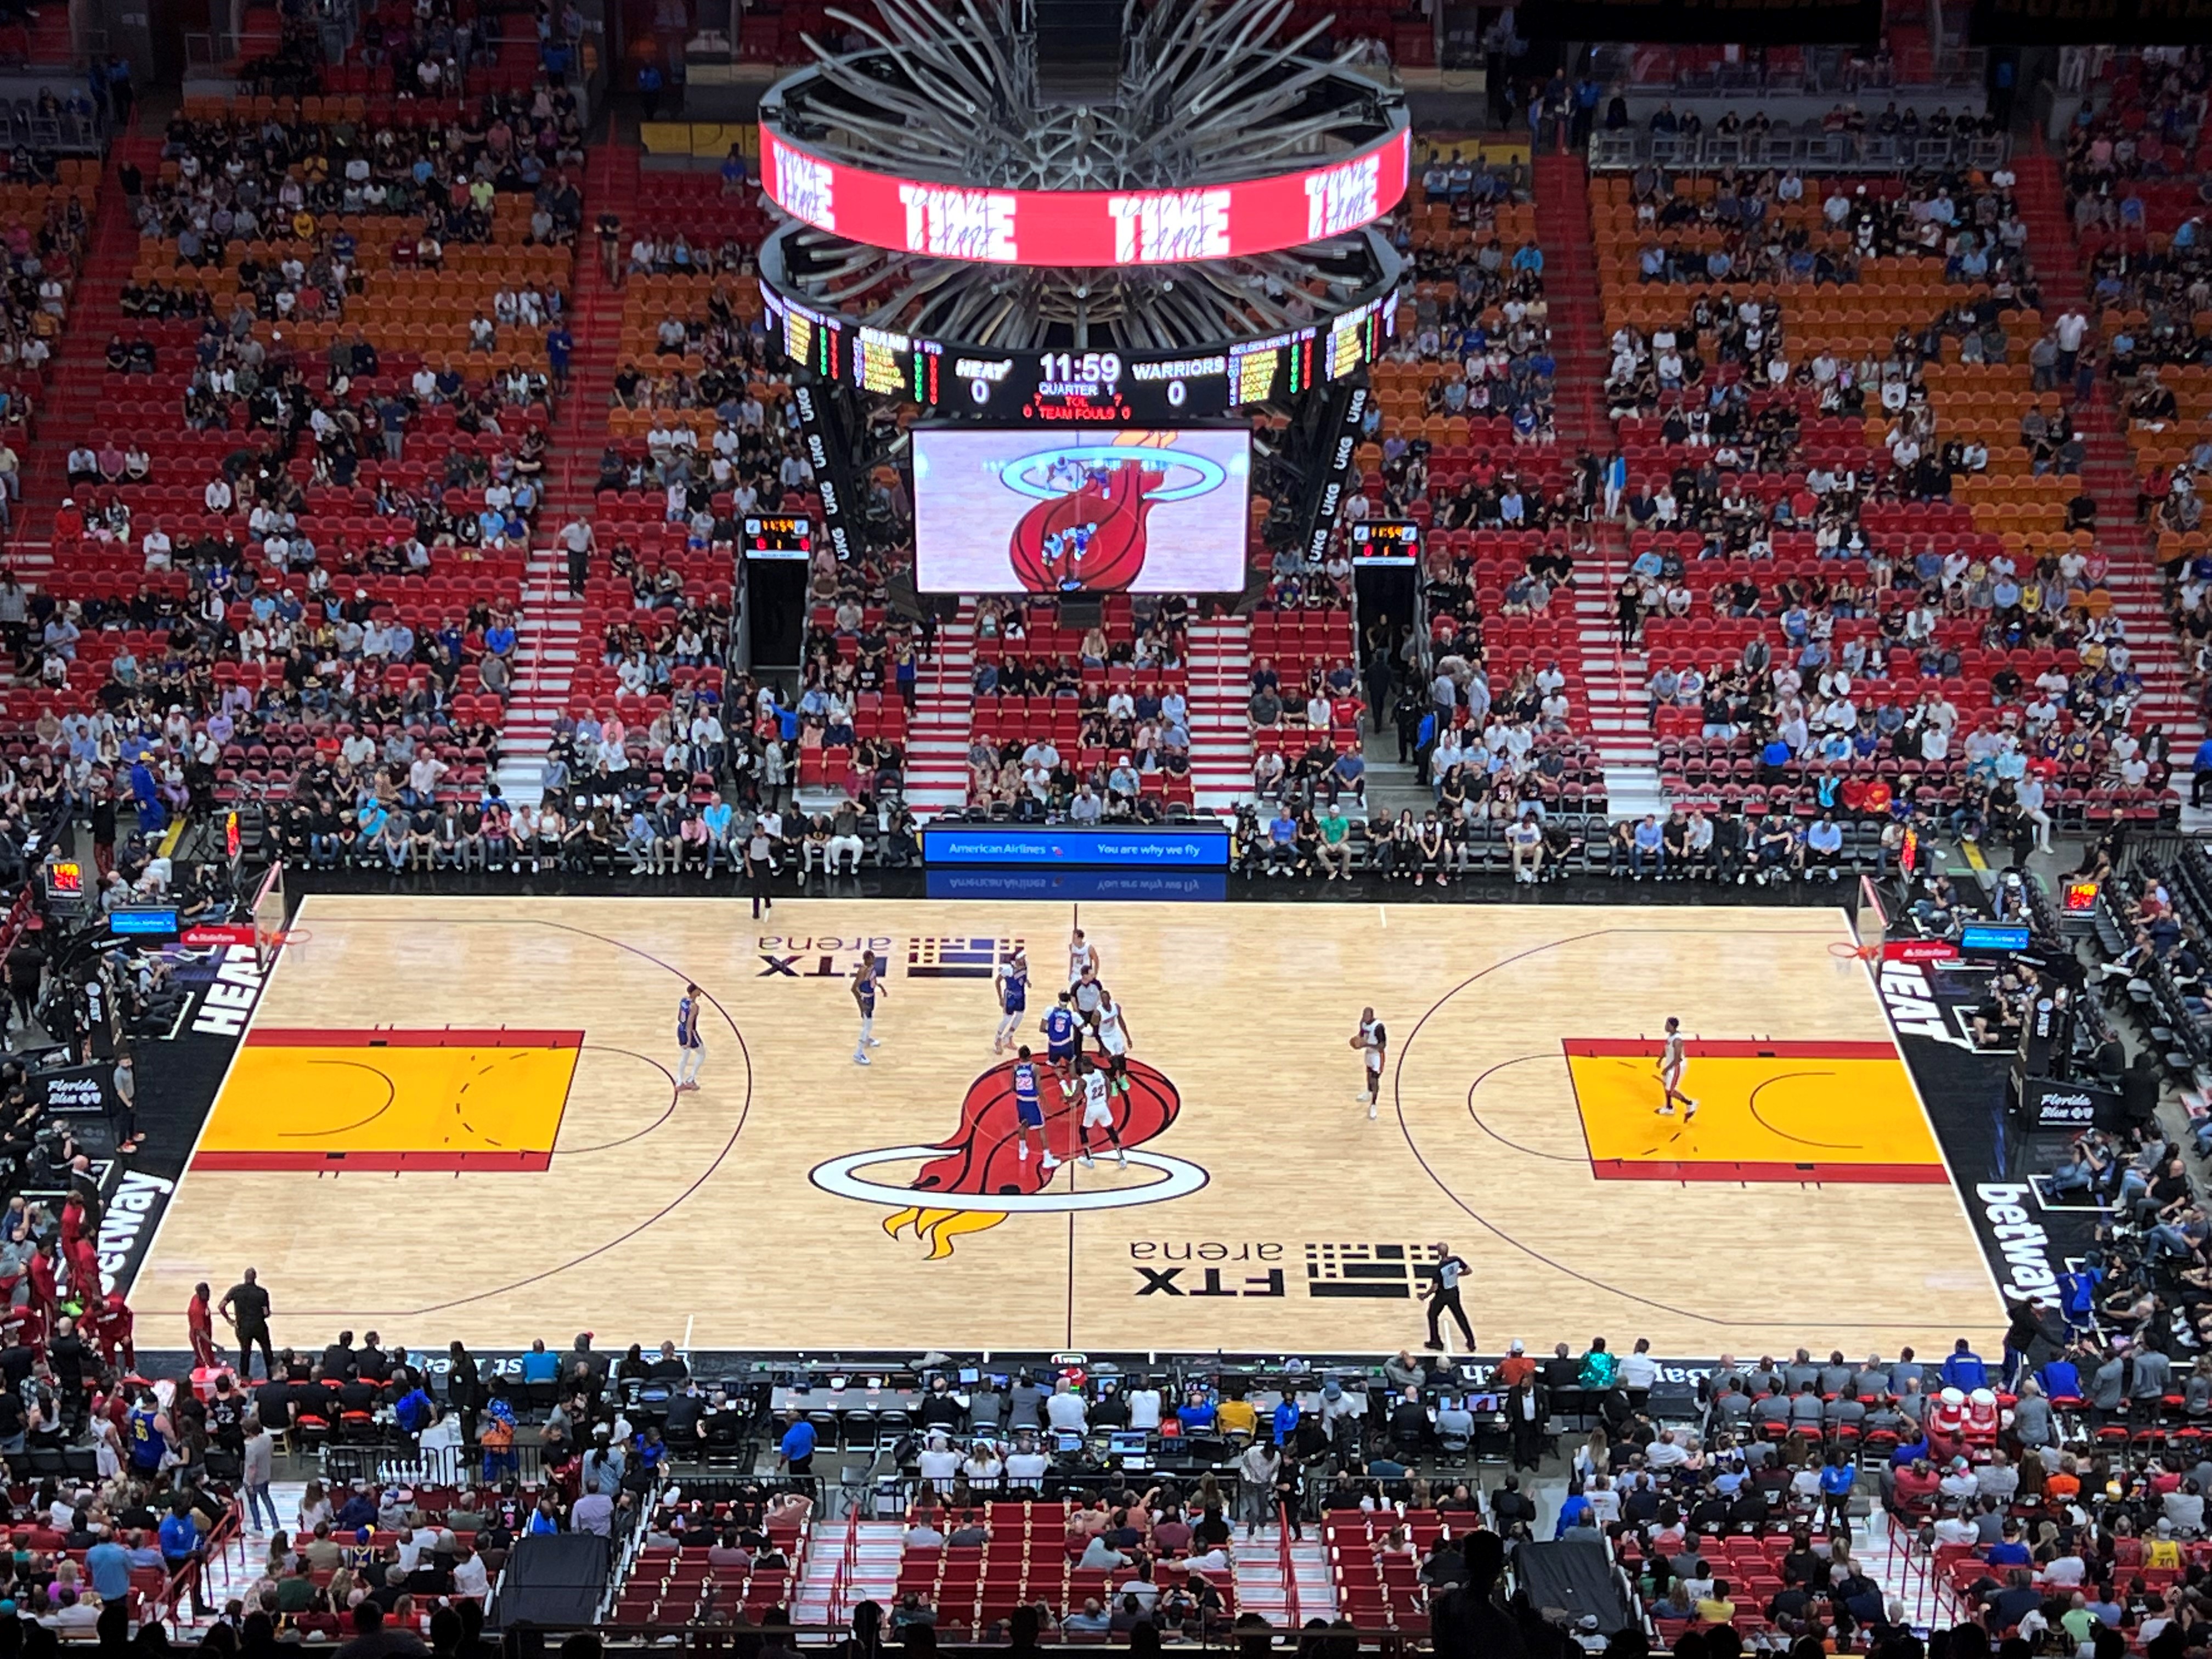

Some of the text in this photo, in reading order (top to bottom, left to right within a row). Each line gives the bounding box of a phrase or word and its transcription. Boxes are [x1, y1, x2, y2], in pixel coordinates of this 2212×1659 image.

[772, 141, 835, 231] TIME
[1305, 154, 1379, 239] TIME
[899, 184, 1018, 261] TIME
[1108, 189, 1231, 263] TIME
[956, 358, 1012, 381] HEAT
[1041, 352, 1121, 382] 11:59
[1132, 356, 1226, 381] WARRIORS
[972, 380, 989, 403] 0
[1039, 383, 1115, 396] QUARTER 1
[1065, 396, 1088, 407] TOL
[1168, 380, 1186, 405] 0
[795, 387, 815, 422] UKG
[1023, 406, 1131, 420] 0 TEAM FOULS 0
[1346, 388, 1368, 423] UKG
[808, 434, 827, 469] UKG
[1333, 436, 1353, 470] UKG
[820, 481, 838, 515] UKG
[1321, 482, 1341, 516] UKG
[831, 527, 850, 561] UKG
[1308, 529, 1328, 562] UKG
[949, 843, 1046, 854] American Airlines
[1097, 843, 1200, 857] You are why we fly
[758, 936, 891, 950] arena
[755, 955, 888, 977] FTX
[47, 1078, 99, 1092] Florida
[1092, 1085, 1104, 1099] 22
[48, 1092, 78, 1104] Blue
[2040, 1093, 2092, 1105] Florida
[2039, 1105, 2069, 1118] Blue
[1130, 1242, 1283, 1261] arena
[1976, 1183, 2061, 1309] betway
[1132, 1266, 1285, 1297] FTX
[217, 1412, 235, 1424] 22
